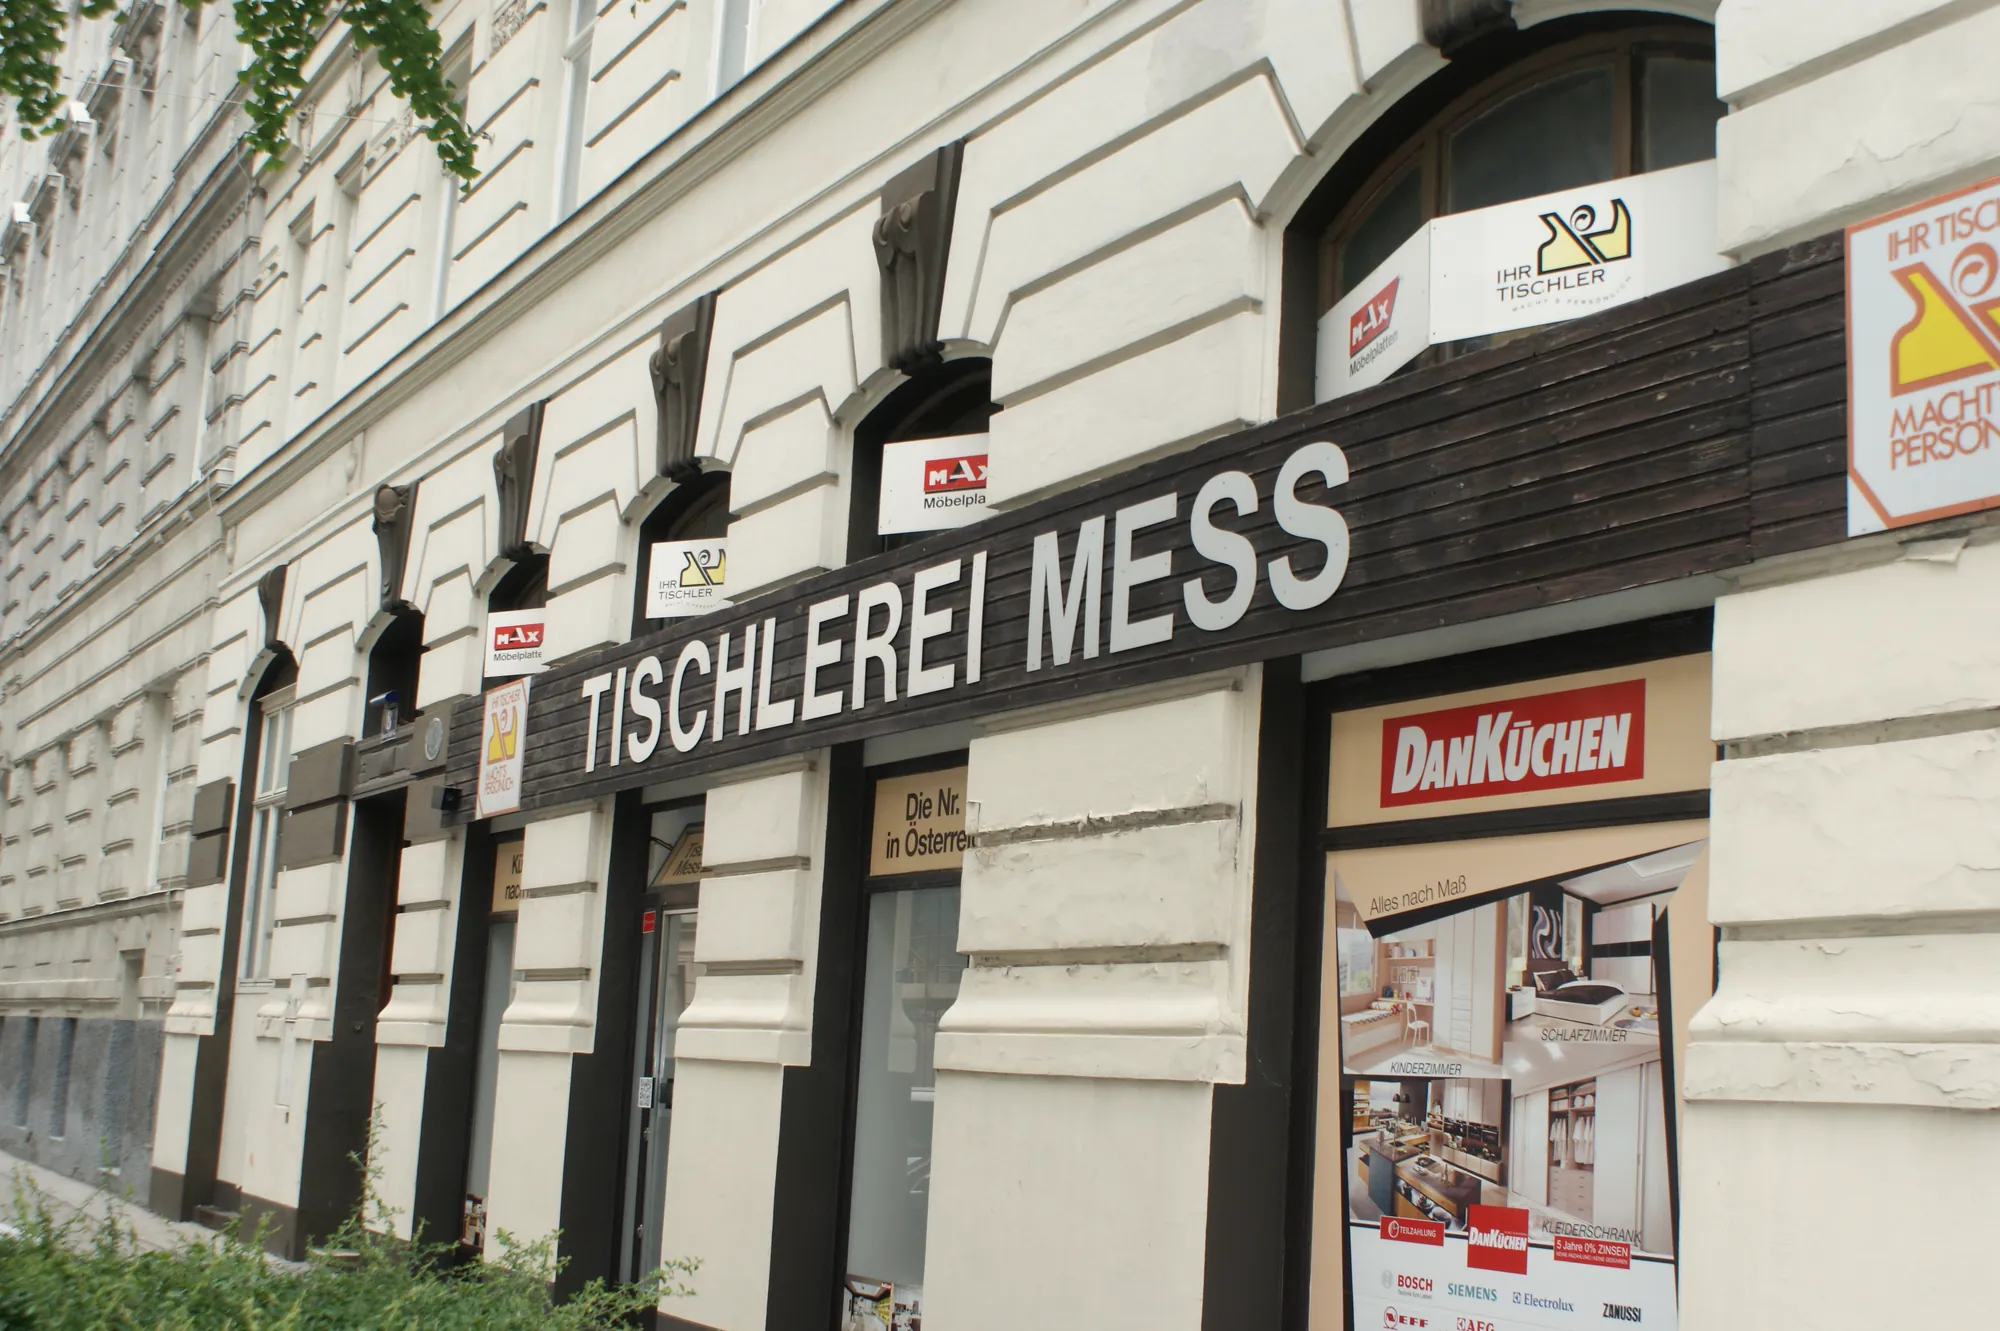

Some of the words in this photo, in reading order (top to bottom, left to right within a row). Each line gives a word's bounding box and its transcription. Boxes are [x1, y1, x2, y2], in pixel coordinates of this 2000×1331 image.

[1888, 222, 1930, 262] IHR
[1935, 197, 2000, 245] TISC
[1497, 265, 1532, 284] IHR
[1496, 268, 1605, 301] TISCHLER
[1349, 330, 1399, 378] Möbelplatten
[659, 580, 677, 590] IHR
[659, 588, 712, 600] TISCHLER
[582, 551, 988, 774] TISCHLEREI
[1026, 441, 1350, 673] MESS
[906, 792, 932, 821] Die
[938, 787, 960, 817] Nr.
[886, 831, 900, 859] in
[1370, 895, 1399, 916] Alles
[1402, 884, 1433, 908] nach
[1437, 874, 1467, 898] Maß
[1541, 1028, 1627, 1042] SCHLAFZIMMER
[1390, 1062, 1462, 1076] KINDERZIMMER
[1400, 1226, 1437, 1238] TEILZAHLUNG
[1541, 1219, 1643, 1247] KLEIDERSCHRANK
[1556, 1239, 1562, 1250] 5
[1563, 1240, 1583, 1252] Jahre
[1584, 1243, 1597, 1254] 0%
[1598, 1244, 1628, 1257] ZINSEN
[1398, 1274, 1433, 1292] BOSCH
[1448, 1283, 1498, 1302] SIEMENS
[1524, 1293, 1574, 1312] Electrolux
[1602, 1303, 1641, 1323] ZANUSSI
